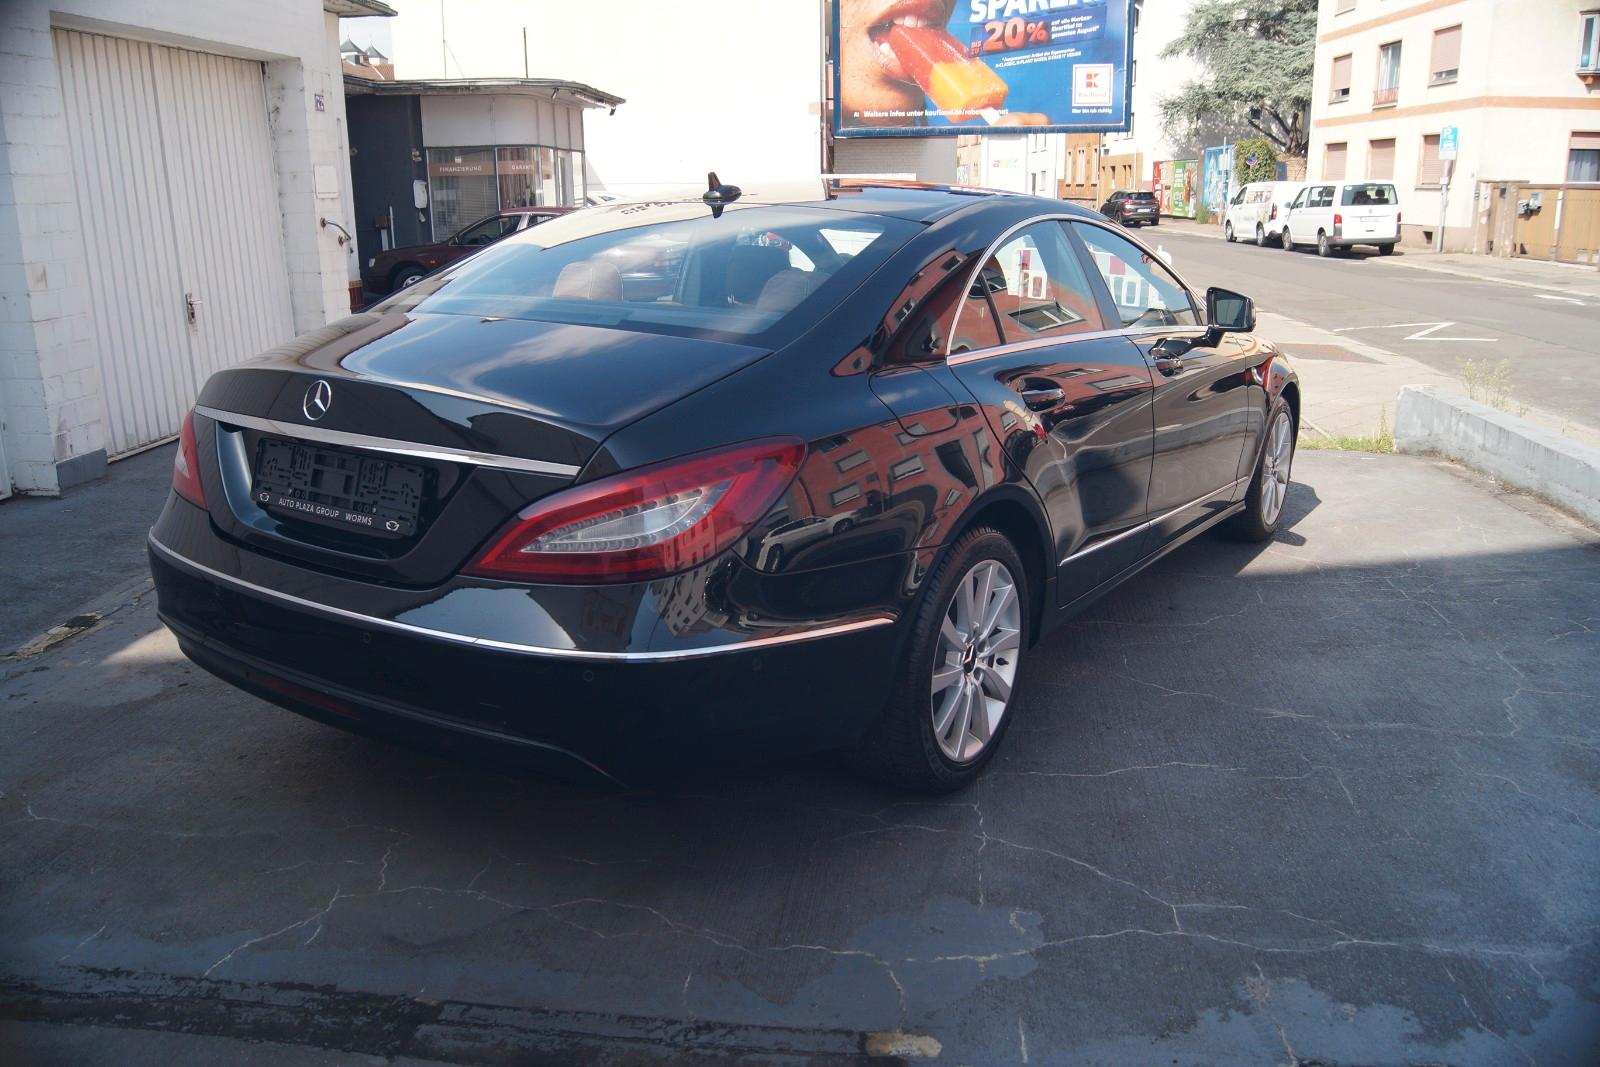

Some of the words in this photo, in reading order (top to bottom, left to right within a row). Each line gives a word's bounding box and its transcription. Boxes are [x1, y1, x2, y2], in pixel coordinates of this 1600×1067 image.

[969, 0, 1093, 23] SPAR
[278, 497, 295, 508] AUTO
[295, 501, 314, 513] PLAZA
[315, 505, 340, 518] GROUP
[345, 512, 373, 526] WORMS
